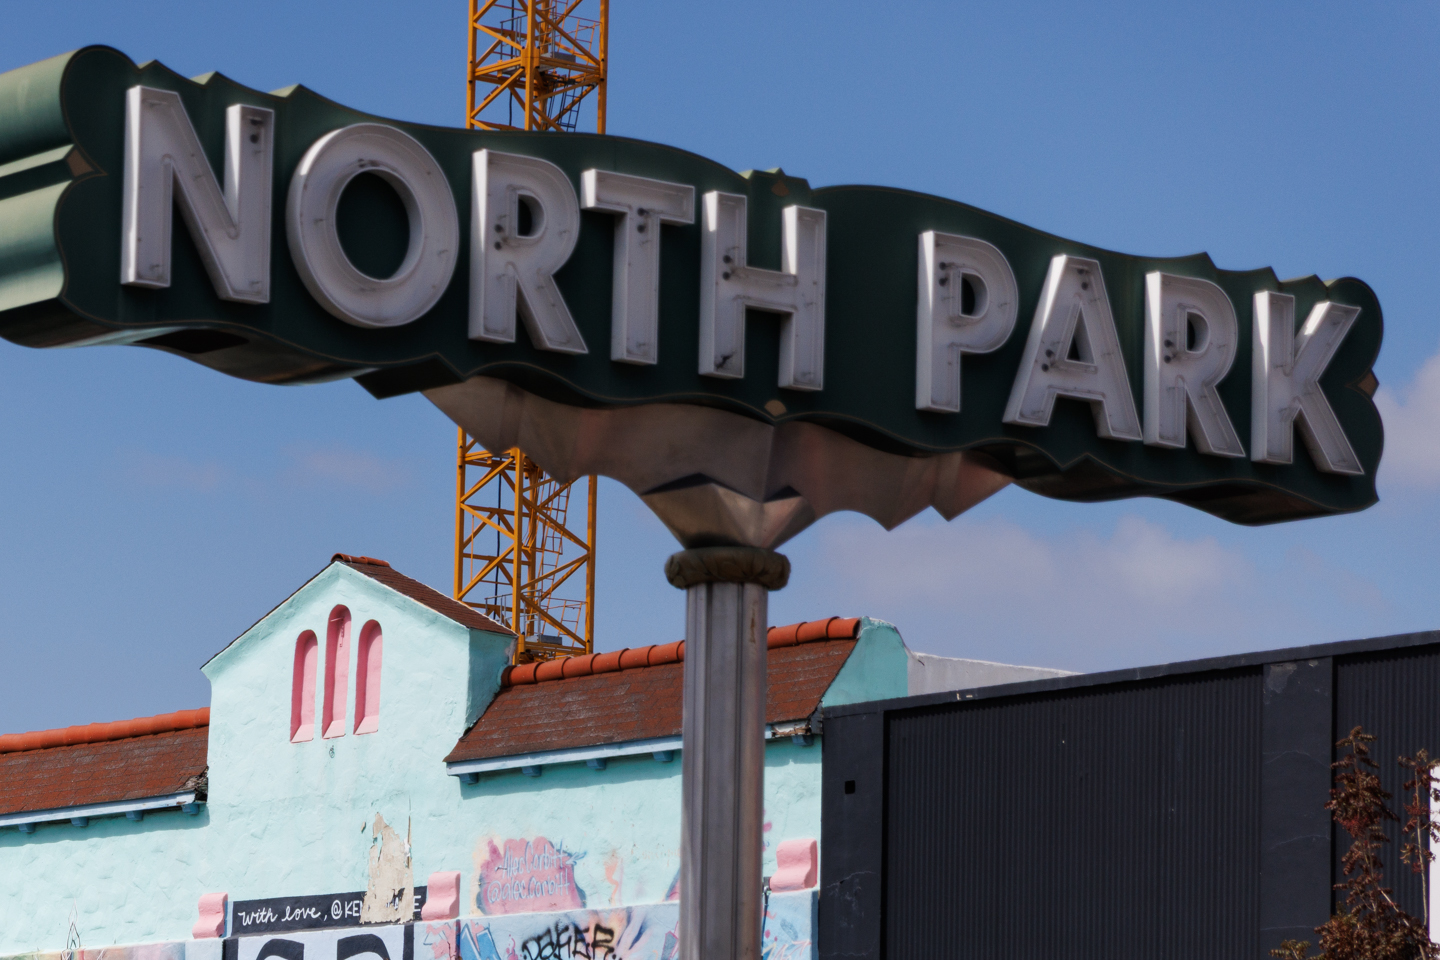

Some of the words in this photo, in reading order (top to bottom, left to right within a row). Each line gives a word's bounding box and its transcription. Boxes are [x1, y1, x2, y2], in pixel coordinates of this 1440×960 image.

[120, 84, 827, 392] NORTH
[915, 230, 1367, 475] PARK
[238, 909, 278, 926] with
